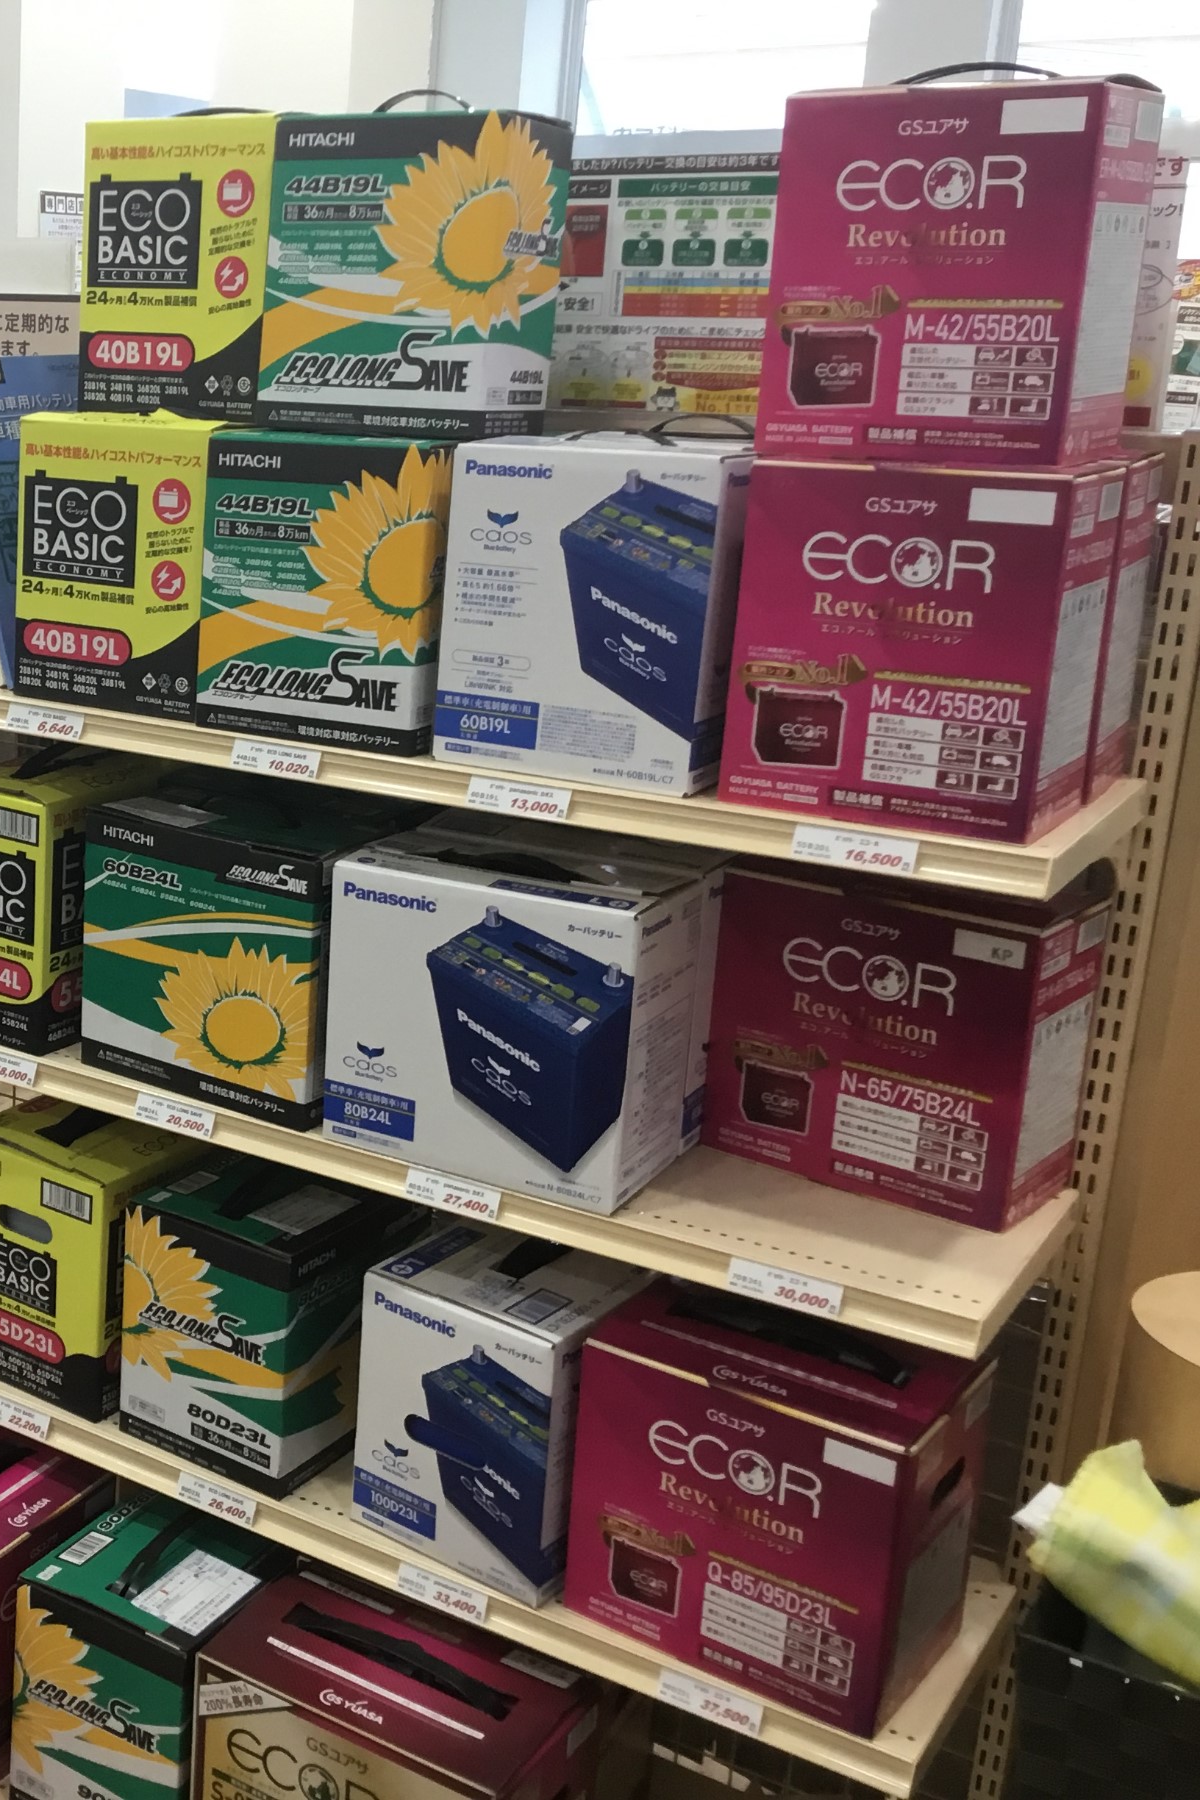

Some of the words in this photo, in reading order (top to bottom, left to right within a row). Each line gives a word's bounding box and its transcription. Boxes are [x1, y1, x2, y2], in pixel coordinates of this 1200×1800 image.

[898, 117, 969, 136] GSユアサ
[289, 132, 355, 147] HITACHI
[285, 174, 385, 196] 44B19L
[99, 188, 191, 232] ECO
[98, 234, 188, 266] BASIC
[100, 270, 185, 280] ECONOMY
[903, 313, 1060, 343] M-42/55B20L
[96, 340, 182, 366] 40B19L
[509, 370, 544, 385] 44B19L
[363, 414, 469, 429] 環境対応車対応バッテリー
[218, 453, 281, 469] HITACHI
[465, 459, 553, 480] Panasonic
[34, 485, 127, 532] ECO
[216, 494, 313, 517] 44B19L
[865, 497, 938, 515] GSユアサ
[33, 528, 125, 562] BASIC
[36, 561, 122, 579] ECONOMY
[590, 586, 678, 645] Panasonic
[31, 629, 120, 660] 40B19L
[19, 666, 42, 678] 28B19L
[46, 669, 69, 681] 34B19L
[73, 673, 98, 685] 36B20L
[101, 678, 126, 690] 38B19L
[19, 676, 42, 688] 38B20L
[45, 679, 69, 691] 40B19L
[73, 684, 97, 696] 40B20L
[871, 683, 1027, 726] M-42/55B20L
[37, 720, 74, 736] 6,640
[460, 714, 511, 735] 60B19L
[298, 726, 399, 748] 環境対応車対応バッテリー
[269, 758, 309, 776] 10,020
[510, 796, 558, 815] 13,000
[102, 825, 154, 847] HITACHI
[844, 847, 902, 868] 16,500
[102, 857, 183, 891] 60B24L
[343, 881, 437, 913] Panasonic
[567, 923, 622, 940] カーバッテリー
[841, 918, 902, 941] GSユアサ
[2, 1016, 28, 1032] 55B24L
[457, 1008, 541, 1073] Panasonic
[199, 1080, 285, 1114] 環境対応車対応バッテリー
[841, 1069, 982, 1128] N-65/75B24L
[165, 1113, 205, 1133] 20,500
[343, 1101, 391, 1126] 80B24L
[442, 1193, 489, 1214] 27,400
[774, 1285, 830, 1310] 30,000
[374, 1291, 457, 1339] Panasonic
[8, 1414, 41, 1435] 22,200
[187, 1403, 272, 1449] 80D23L
[705, 1408, 765, 1437] GSユアサ
[208, 1498, 246, 1520] 26,400
[370, 1488, 420, 1525] 100D23L
[433, 1589, 476, 1615] 33,400
[707, 1561, 837, 1631] Q-85/95D23L
[699, 1699, 750, 1727] 37,500
[306, 1737, 369, 1775] GSユアサ
